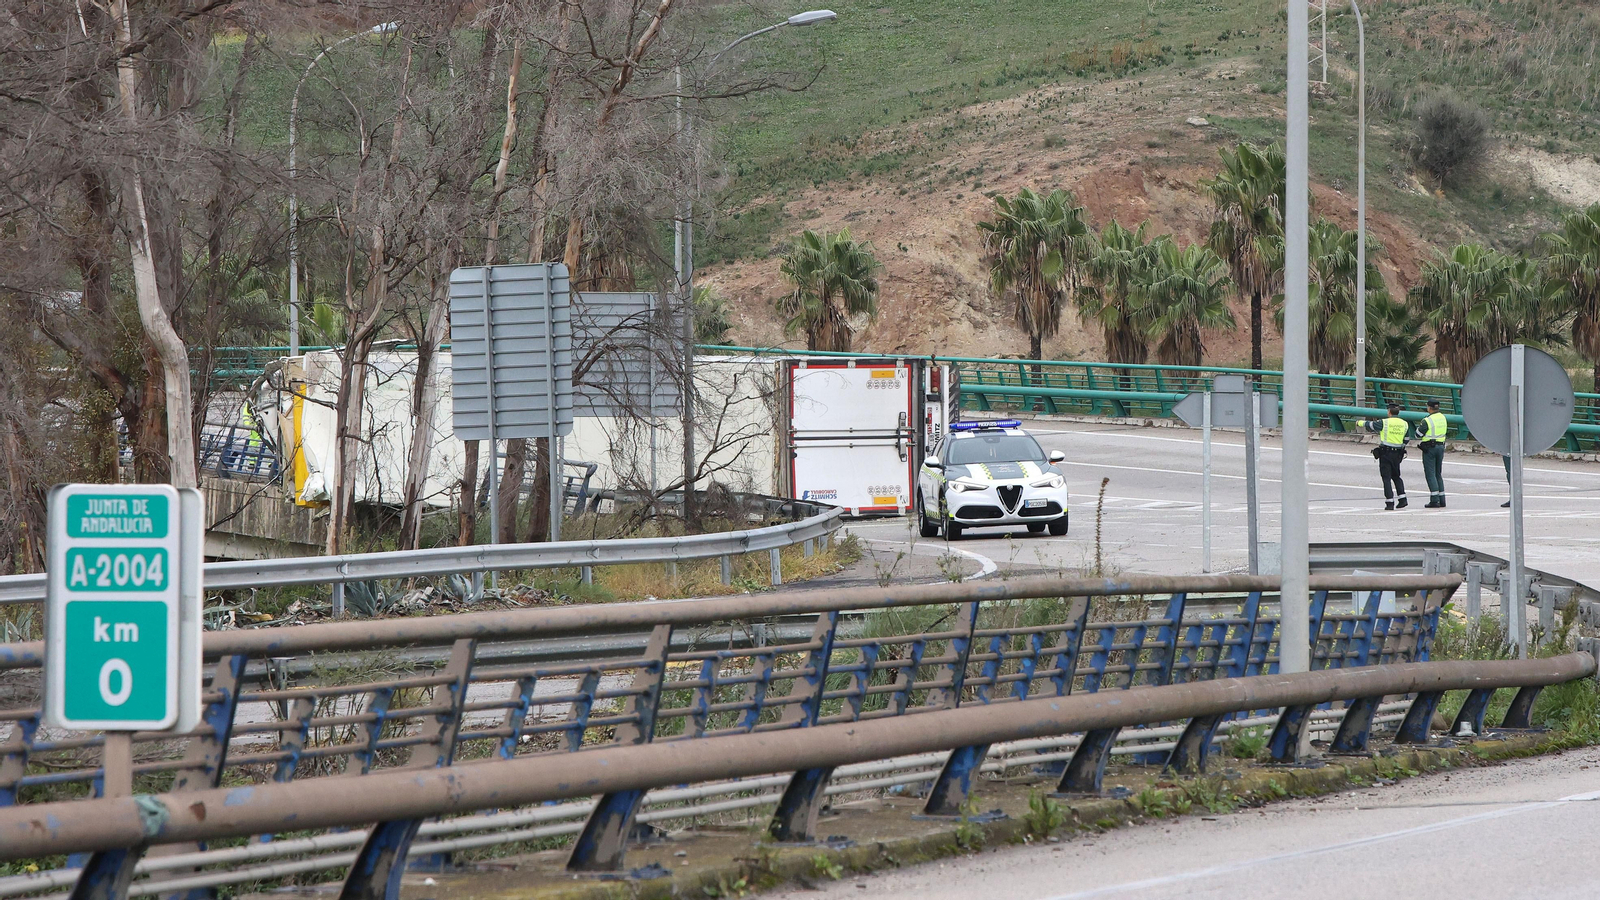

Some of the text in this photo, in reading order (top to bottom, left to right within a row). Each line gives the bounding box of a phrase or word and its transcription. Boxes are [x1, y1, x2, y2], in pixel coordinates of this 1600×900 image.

[85, 499, 149, 515] JUNTA DE
[70, 553, 164, 587] A-2004
[94, 616, 139, 642] km
[98, 658, 133, 707] 0
